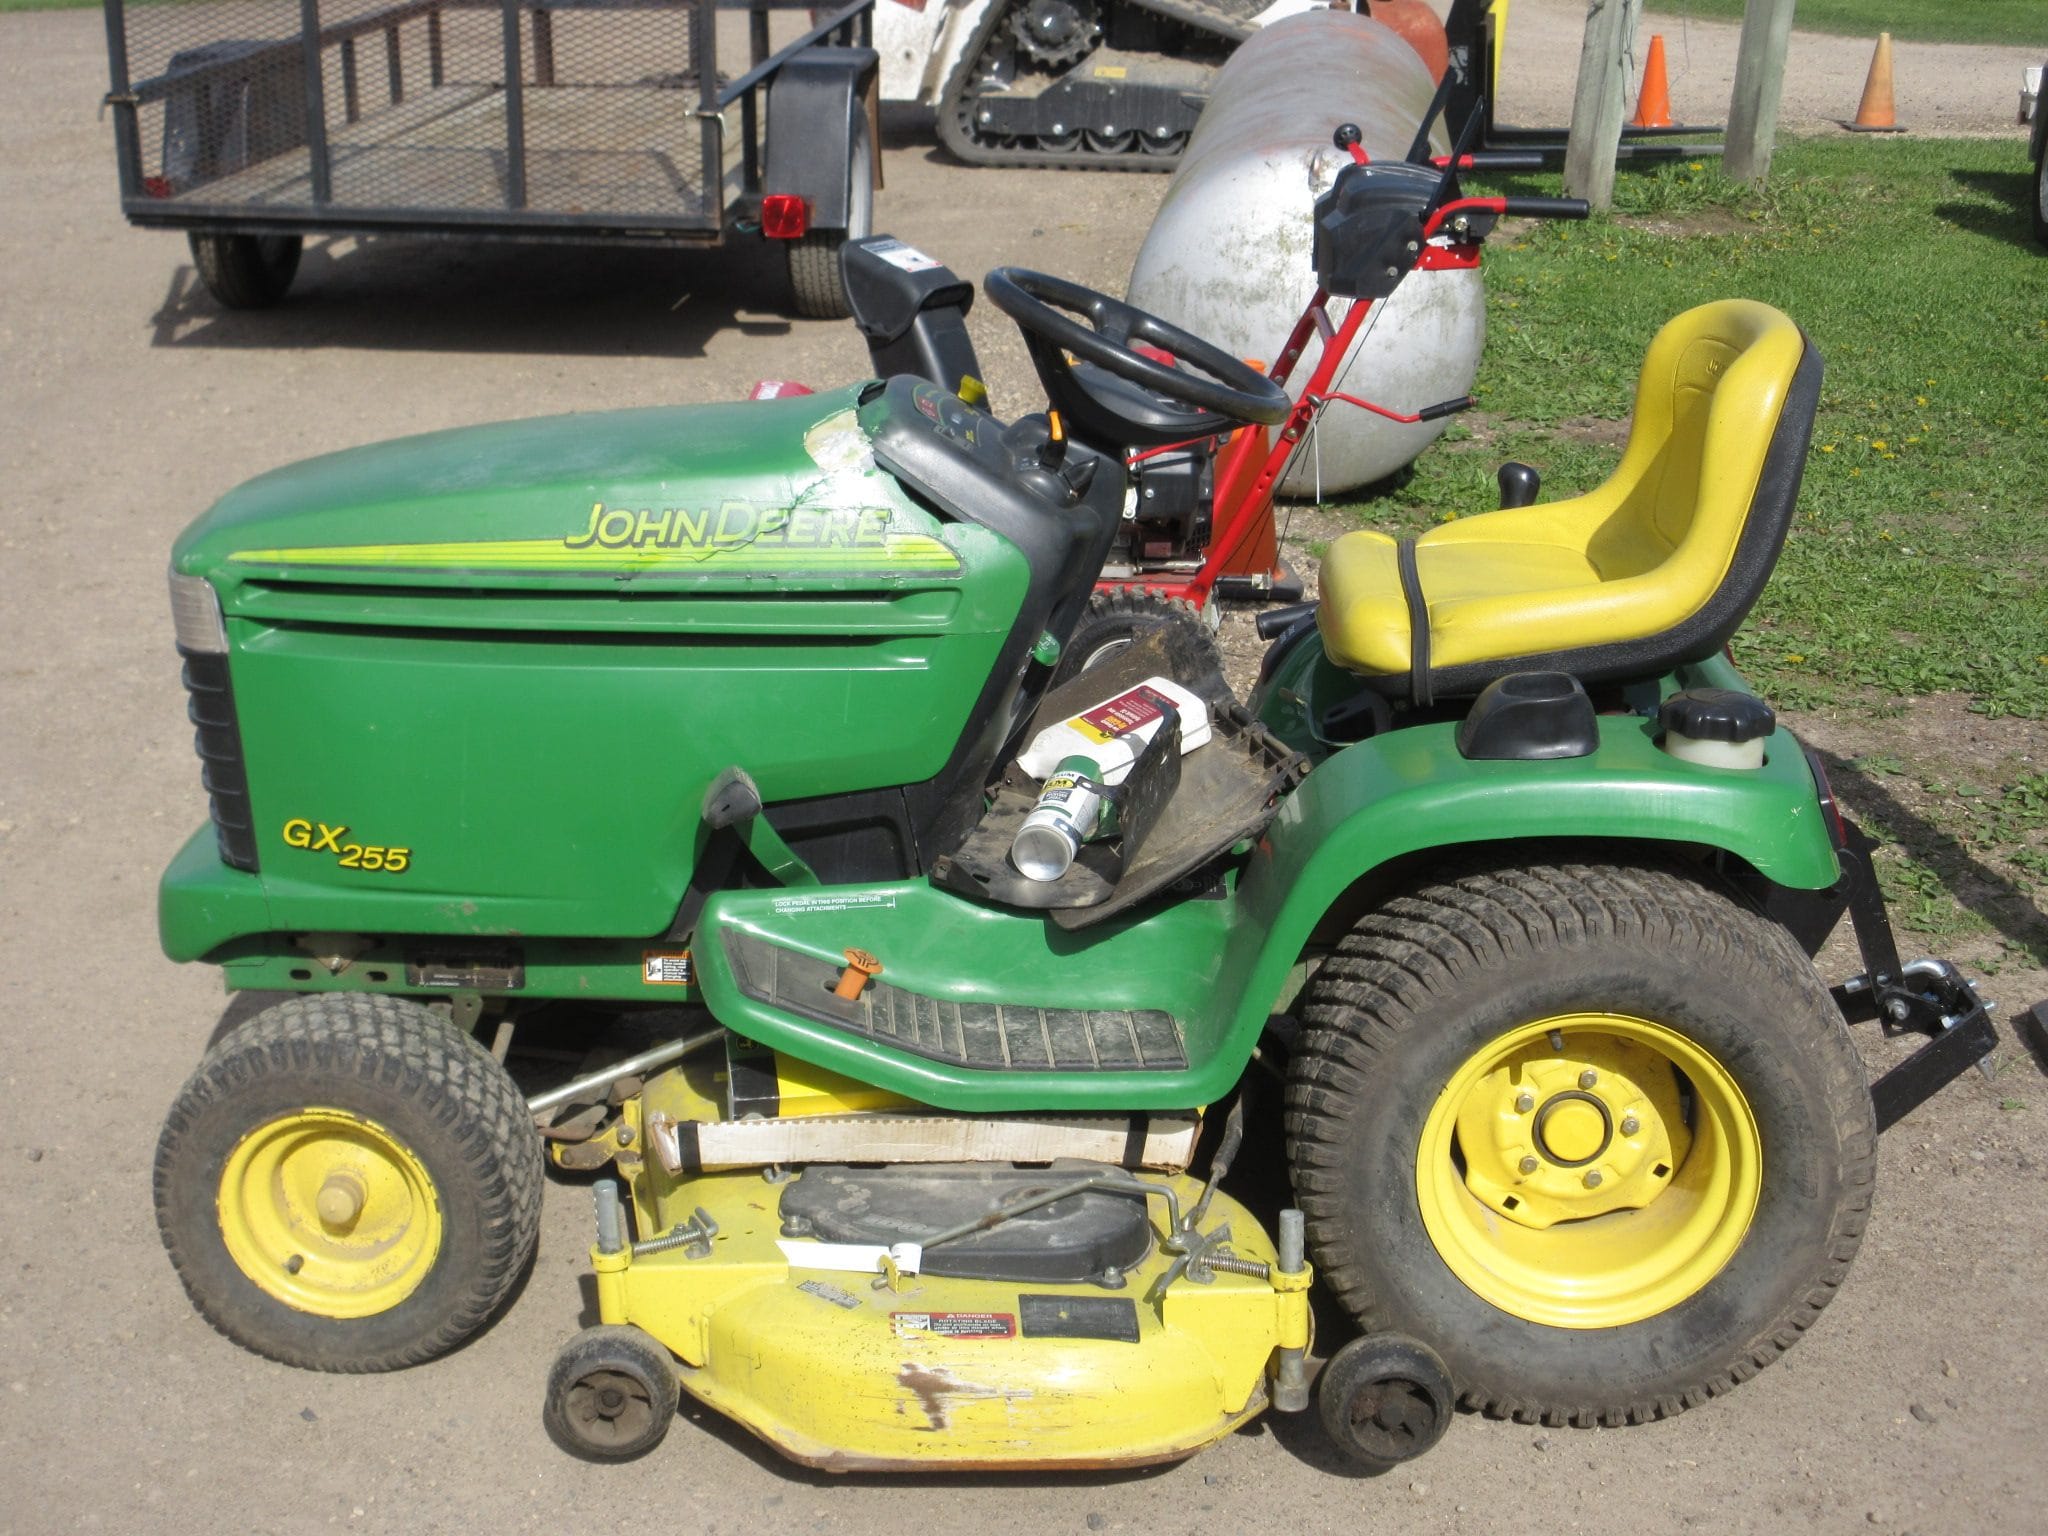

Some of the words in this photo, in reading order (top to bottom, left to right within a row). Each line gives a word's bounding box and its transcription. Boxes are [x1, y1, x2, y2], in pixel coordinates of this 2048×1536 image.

[565, 502, 710, 549] JOHN
[711, 502, 891, 549] DEERE
[283, 818, 350, 854] GX
[339, 844, 412, 873] 255
